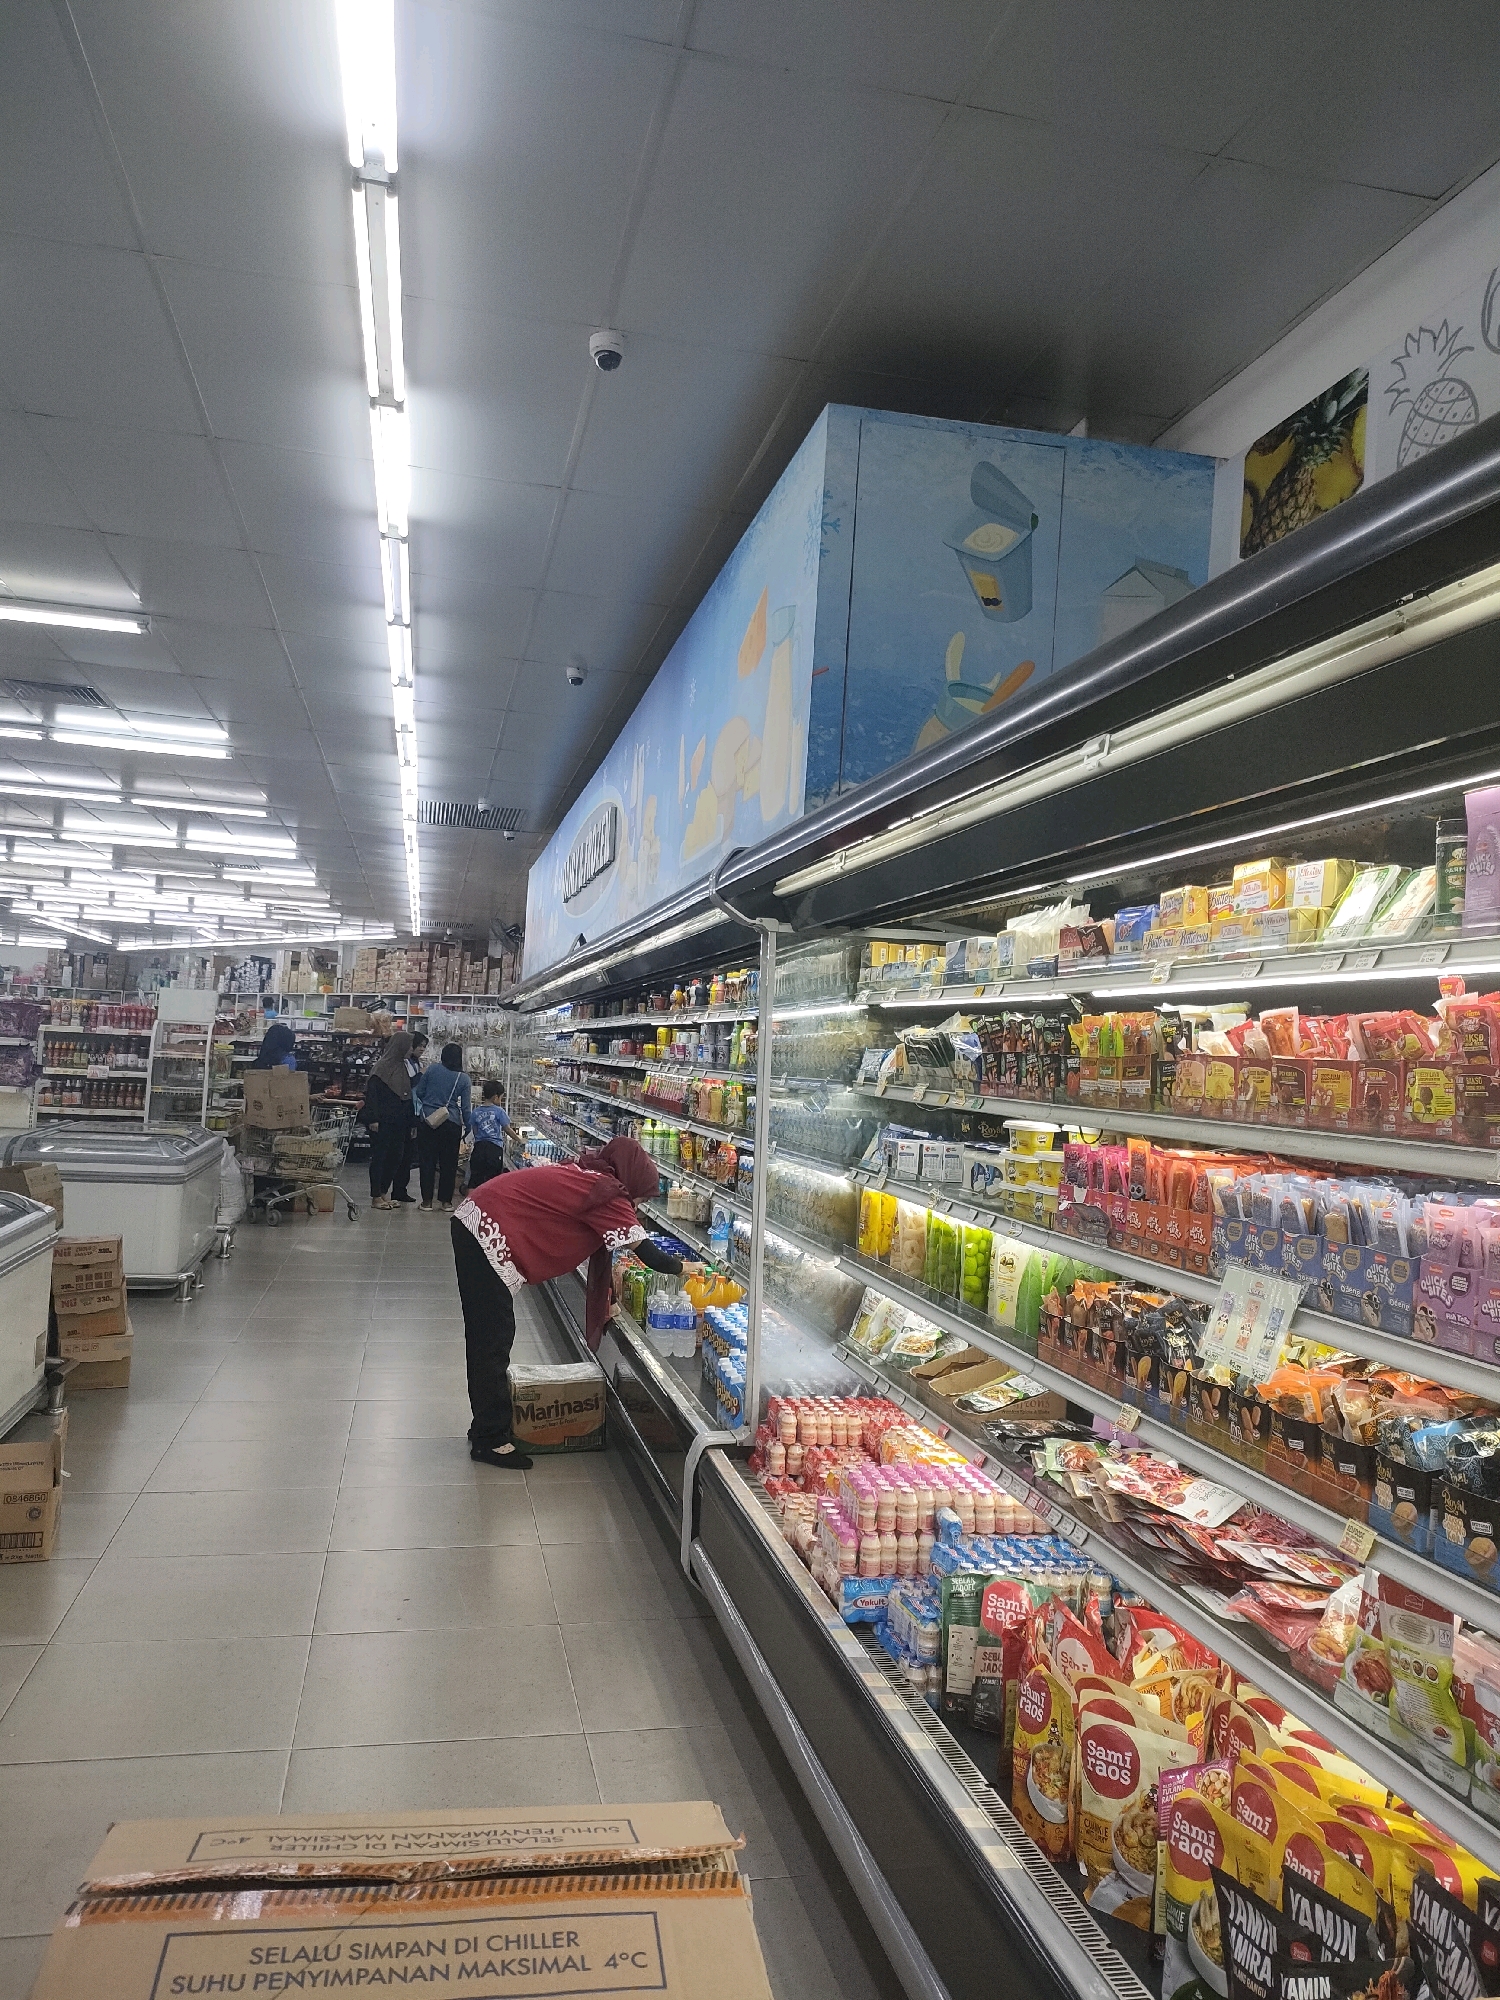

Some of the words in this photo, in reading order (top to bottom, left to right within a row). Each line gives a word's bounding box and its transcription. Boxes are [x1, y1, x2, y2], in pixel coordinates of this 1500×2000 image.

[1465, 1034, 1484, 1042] AKSO
[1420, 1274, 1448, 1293] QUICK
[1428, 1285, 1455, 1308] BITES
[1481, 1298, 1500, 1315] QUIC
[514, 1392, 600, 1426] Marinasi
[1442, 1487, 1468, 1516] Royal
[860, 1598, 886, 1606] Yakult
[982, 1652, 1002, 1662] SEBL
[1020, 1695, 1044, 1723] raos
[1086, 1740, 1132, 1770] Sami
[1087, 1756, 1131, 1786] raos
[1162, 1784, 1186, 1796] TULANG
[1236, 1796, 1272, 1836] Sami
[268, 1834, 384, 1843] MAKSIMAL
[392, 1828, 554, 1841] PENYIMPANAN
[486, 1836, 564, 1846] SELALU
[562, 1826, 620, 1834] SUHU
[1173, 1811, 1216, 1850] Sami
[270, 1842, 358, 1852] CHILLER
[364, 1842, 386, 1850] DI
[394, 1838, 480, 1850] SIMPAN
[1170, 1829, 1214, 1866] raos
[1285, 1848, 1321, 1885] Sami
[1220, 1884, 1278, 1956] YAMIN
[1290, 1886, 1356, 1962] YAMIN
[250, 1944, 342, 1965] SELALU
[349, 1938, 446, 1960] SIMPAN
[454, 1936, 478, 1955] DI
[486, 1931, 580, 1952] CHILLER
[170, 1973, 247, 1995] SUHU
[253, 1964, 450, 1992] PENYIMPANAN
[458, 1954, 592, 1980] MAKSIMAL
[604, 1951, 649, 1970] 4°C
[1280, 1972, 1331, 2000] YAMIN
